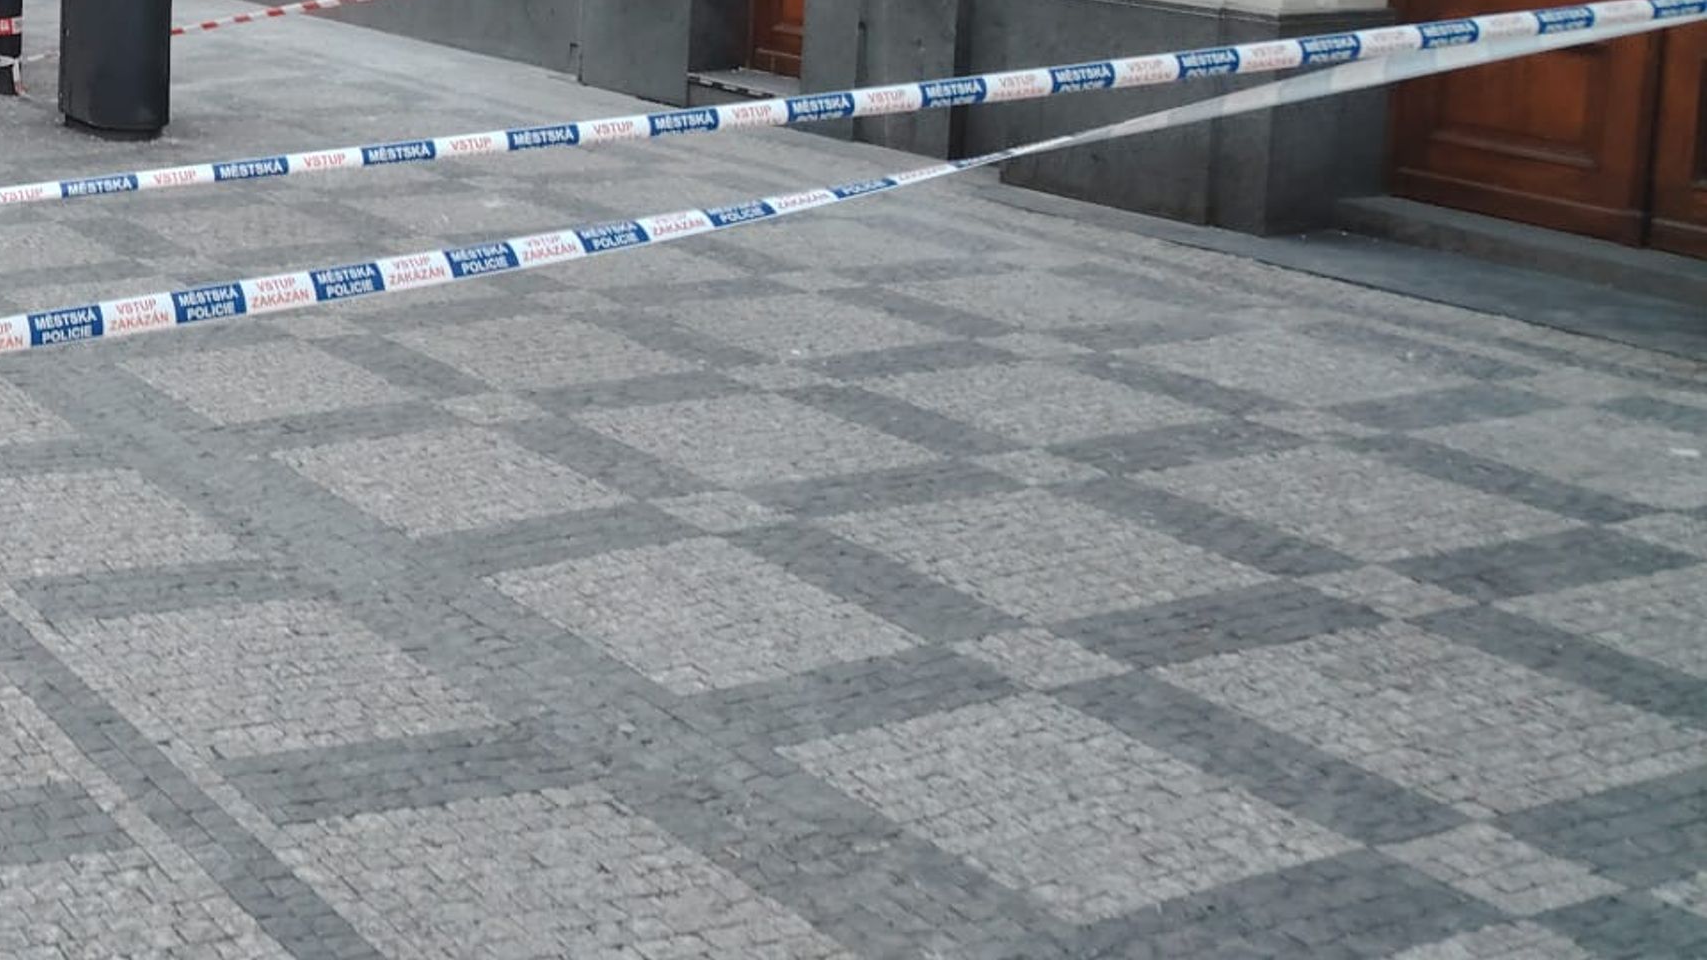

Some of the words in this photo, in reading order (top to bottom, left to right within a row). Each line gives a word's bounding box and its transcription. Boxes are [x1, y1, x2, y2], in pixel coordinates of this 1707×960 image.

[653, 109, 714, 130] MĚSTSKÁ
[731, 105, 772, 120] VSTUP
[513, 124, 574, 146] MĚSTSKÁ
[593, 121, 634, 136] VSTUP
[368, 141, 431, 162] MĚSTSKÁ
[449, 137, 492, 151] VSTUP
[220, 159, 283, 180] MĚSTSKÁ
[303, 153, 346, 168] VSTUP
[153, 171, 196, 185] VSTUP
[0, 187, 44, 203] VSTUP
[594, 232, 637, 250] POLICIE
[522, 242, 577, 263] ZAKÁZÁN
[392, 257, 430, 271] VSTUP
[462, 256, 509, 274] POLICIE
[318, 263, 376, 284] MĚSTSKÁ
[389, 265, 445, 285] ZAKÁZÁN
[257, 278, 295, 292] VSTUP
[326, 280, 374, 298] POLICIE
[178, 284, 239, 307] MĚSTSKÁ
[251, 287, 310, 308] ZAKÁZÁN
[116, 298, 156, 315] VSTUP
[187, 301, 235, 320] POLICIE
[34, 307, 97, 330] MĚSTSKÁ
[110, 311, 169, 331] ZAKÁZÁN
[42, 326, 92, 344] POLICIE
